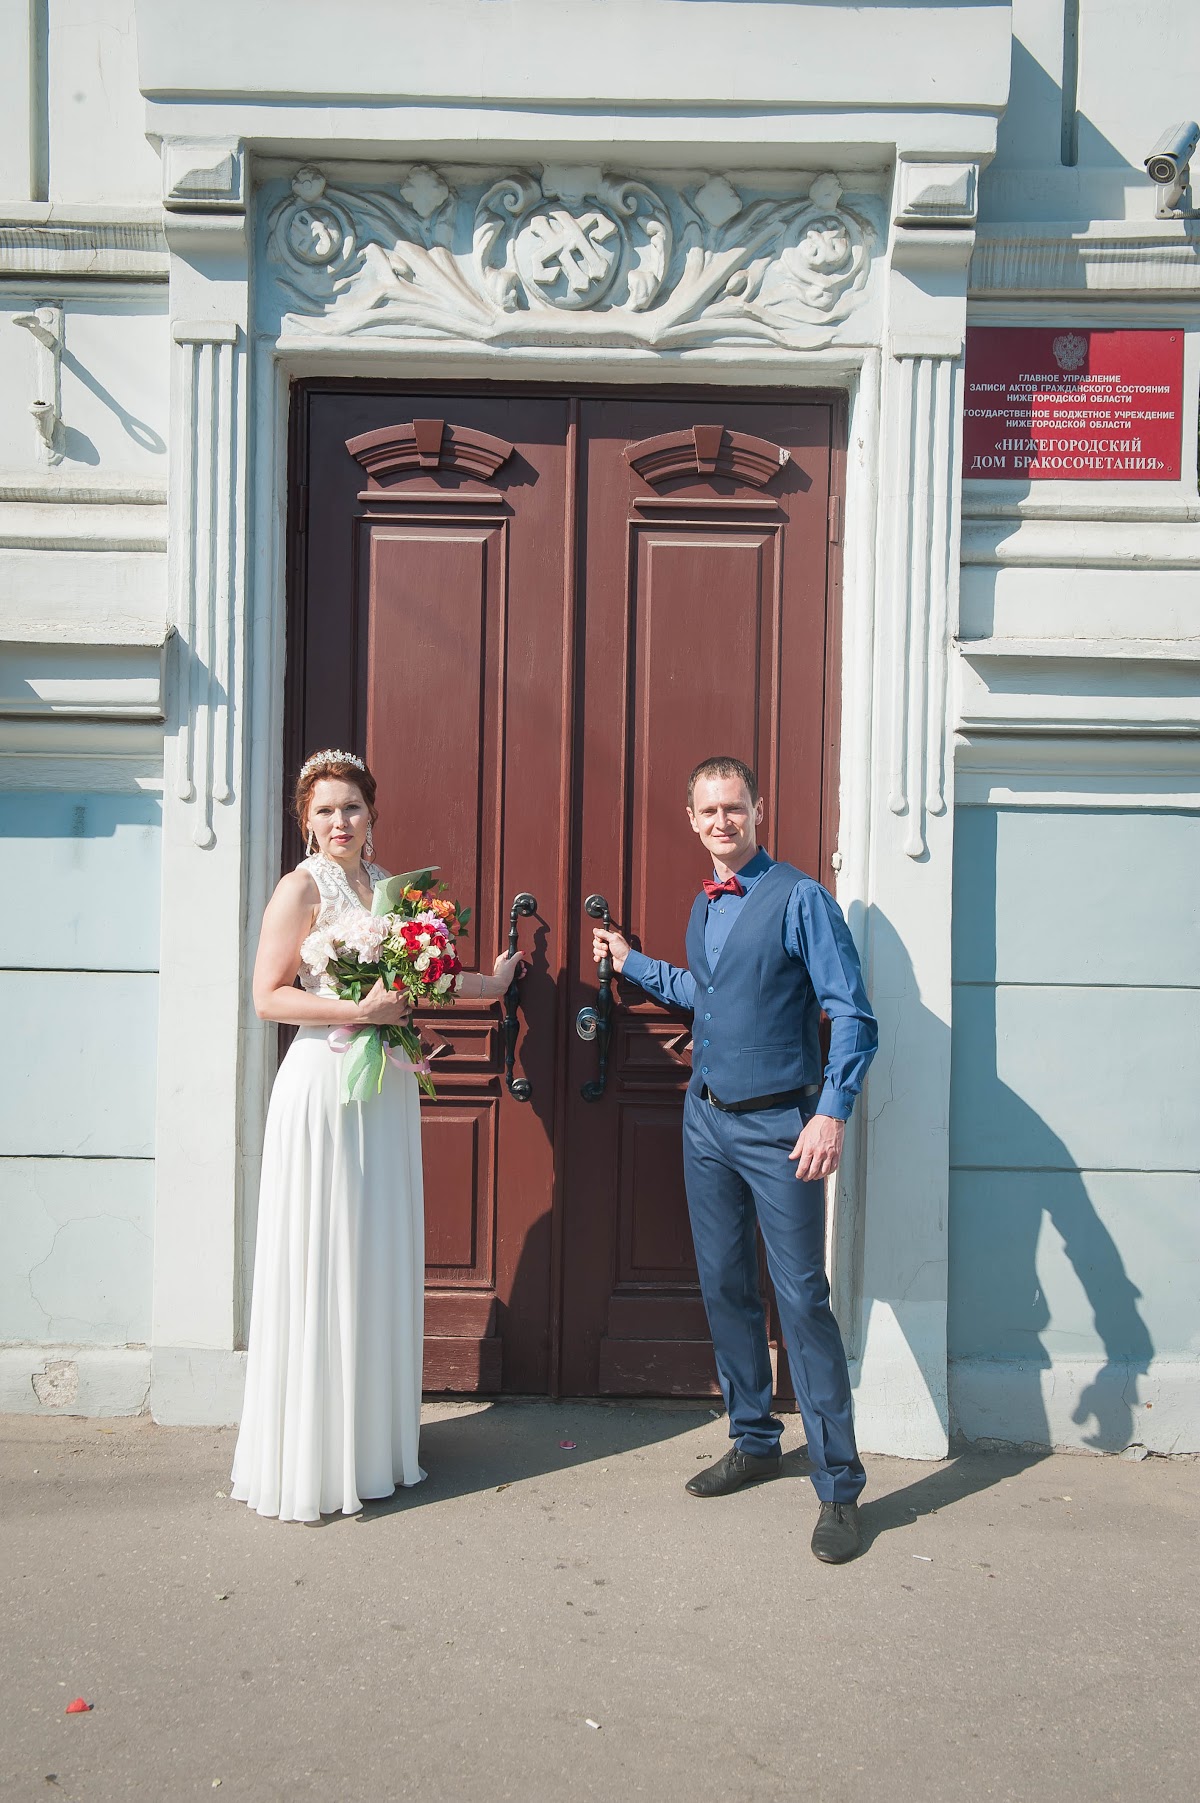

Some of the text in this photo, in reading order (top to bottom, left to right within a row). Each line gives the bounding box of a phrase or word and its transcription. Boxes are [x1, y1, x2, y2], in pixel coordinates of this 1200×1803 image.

[1019, 374, 1121, 383] ГЛАВНОЕ УПРАВЛЕНИЕ
[969, 383, 1170, 393] ЗАПИСИ АКТОВ ГРАЖДАНСКОГО СОСТОЯНИЯ
[1007, 394, 1132, 403] НИЖЕГОРОДСКОЙ ОБЛАСТИ
[963, 409, 1175, 420] ГОСУДАРСТВЕННОЕ БЮДЖЕТНОЕ УЧРЕЖДЕНИЕ
[1006, 420, 1132, 429] НИЖЕГОРОДСКОЙ ОБЛАСТИ
[994, 437, 1142, 454] «НИЖЕГОРОДСКИЙ
[971, 455, 1165, 470] ДОМ БРАКОСОЧЕТАНИЯ»
